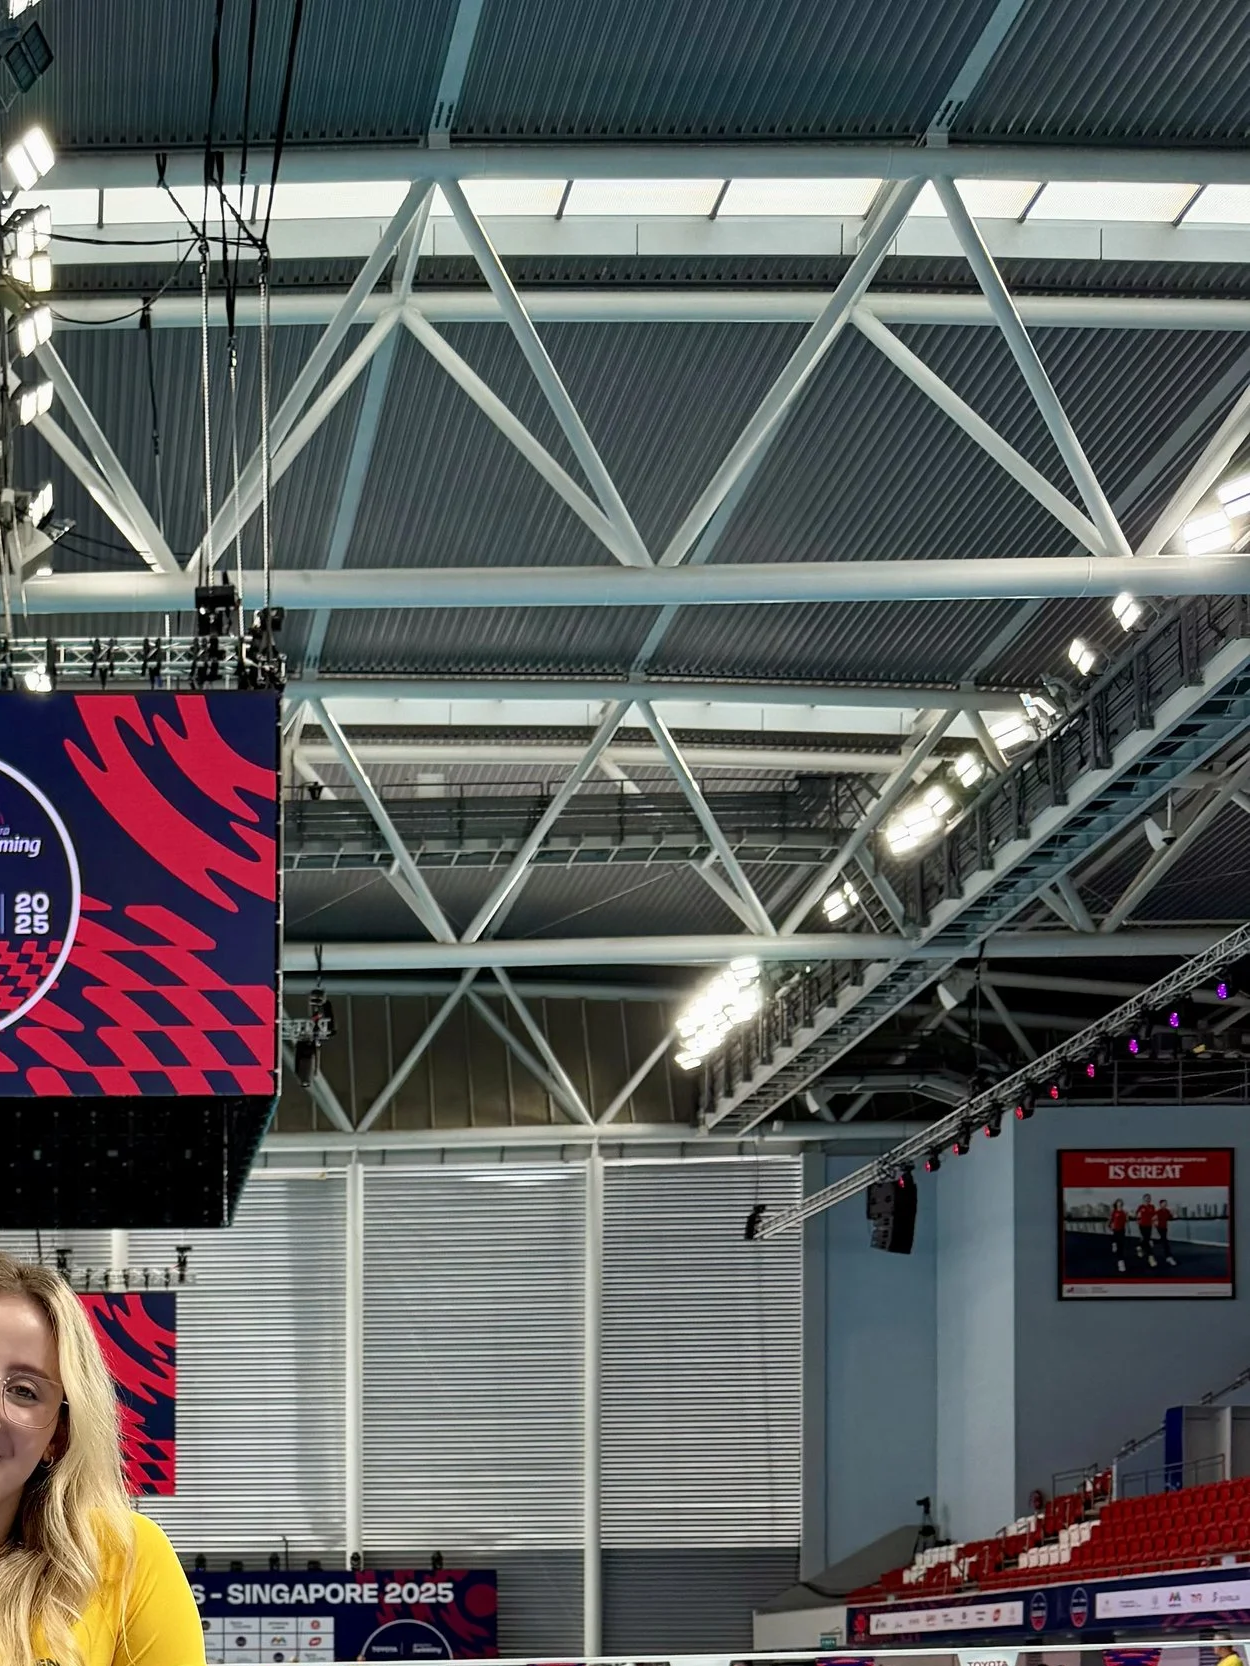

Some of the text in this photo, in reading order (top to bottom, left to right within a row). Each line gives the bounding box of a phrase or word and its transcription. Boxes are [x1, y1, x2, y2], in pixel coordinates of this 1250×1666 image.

[14, 892, 50, 914] 20
[14, 914, 50, 935] 25
[1108, 1165, 1183, 1180] IS GREAT
[227, 1583, 379, 1604] SINGAPORE
[385, 1582, 454, 1604] 2025
